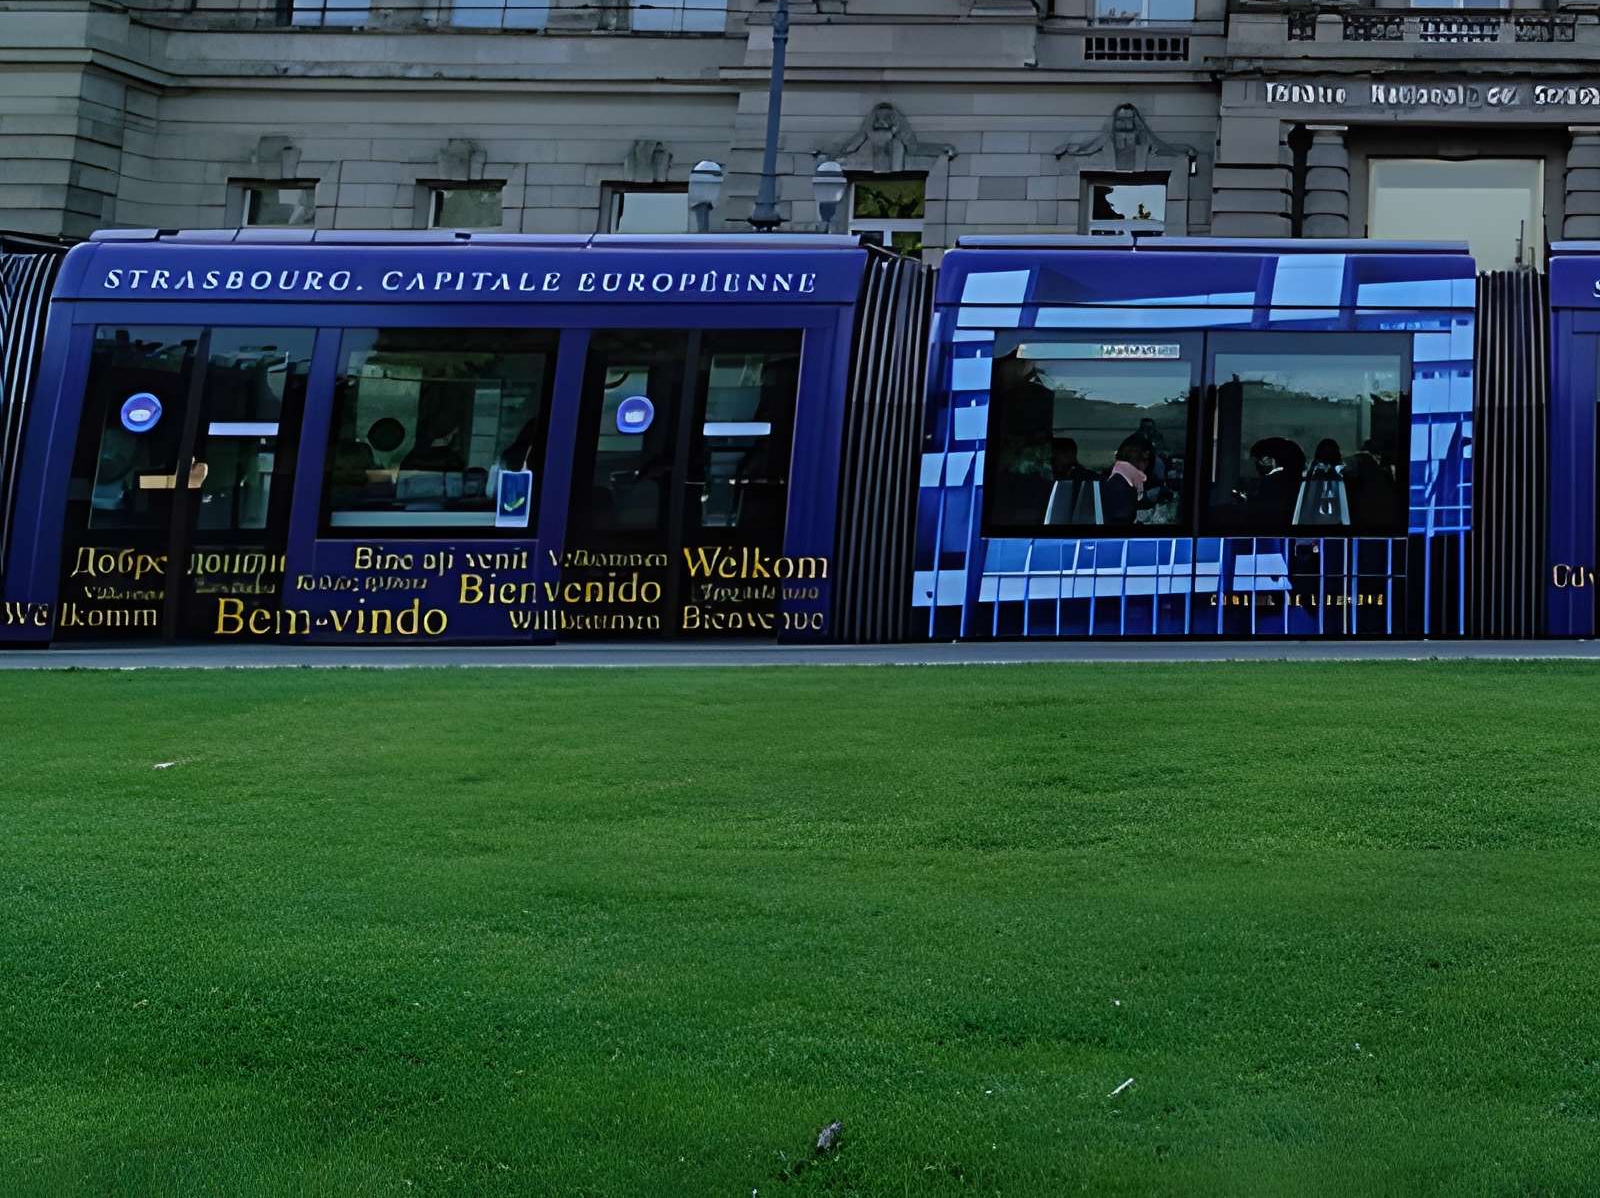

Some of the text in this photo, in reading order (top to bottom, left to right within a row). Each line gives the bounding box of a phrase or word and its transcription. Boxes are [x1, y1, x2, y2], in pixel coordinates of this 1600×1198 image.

[382, 270, 560, 292] CAPITALE
[683, 546, 828, 579] Welkom
[458, 572, 662, 604] Bienvenido
[214, 597, 448, 635] Bem-vindo
